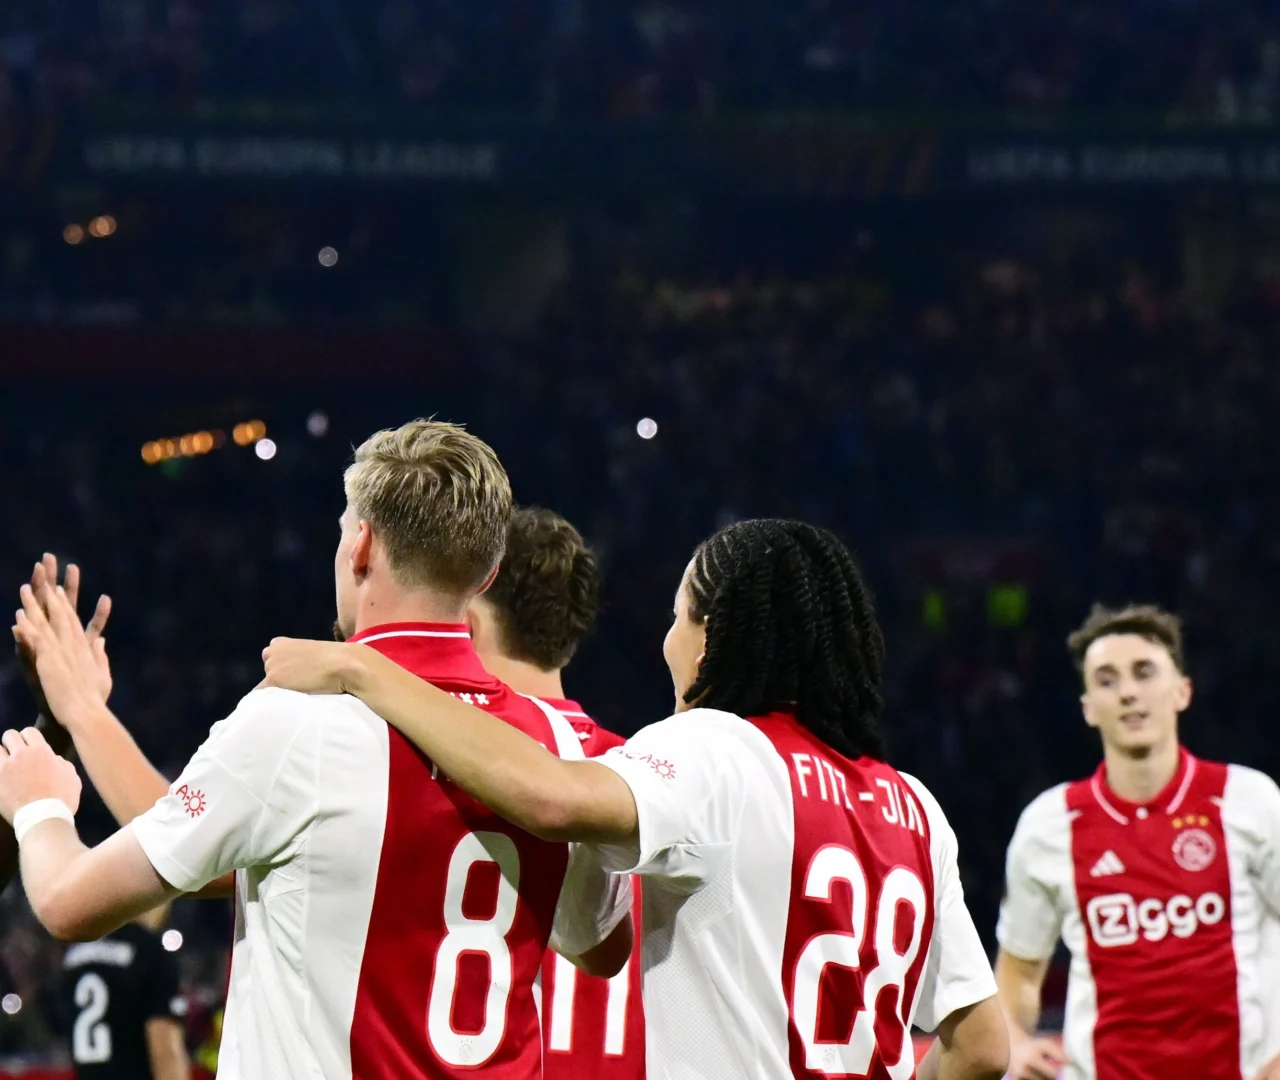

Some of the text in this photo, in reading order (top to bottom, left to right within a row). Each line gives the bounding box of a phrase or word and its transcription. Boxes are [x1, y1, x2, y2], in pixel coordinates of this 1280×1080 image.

[426, 830, 521, 1070] 8
[1087, 892, 1224, 947] Ziggo
[72, 970, 113, 1065] 2
